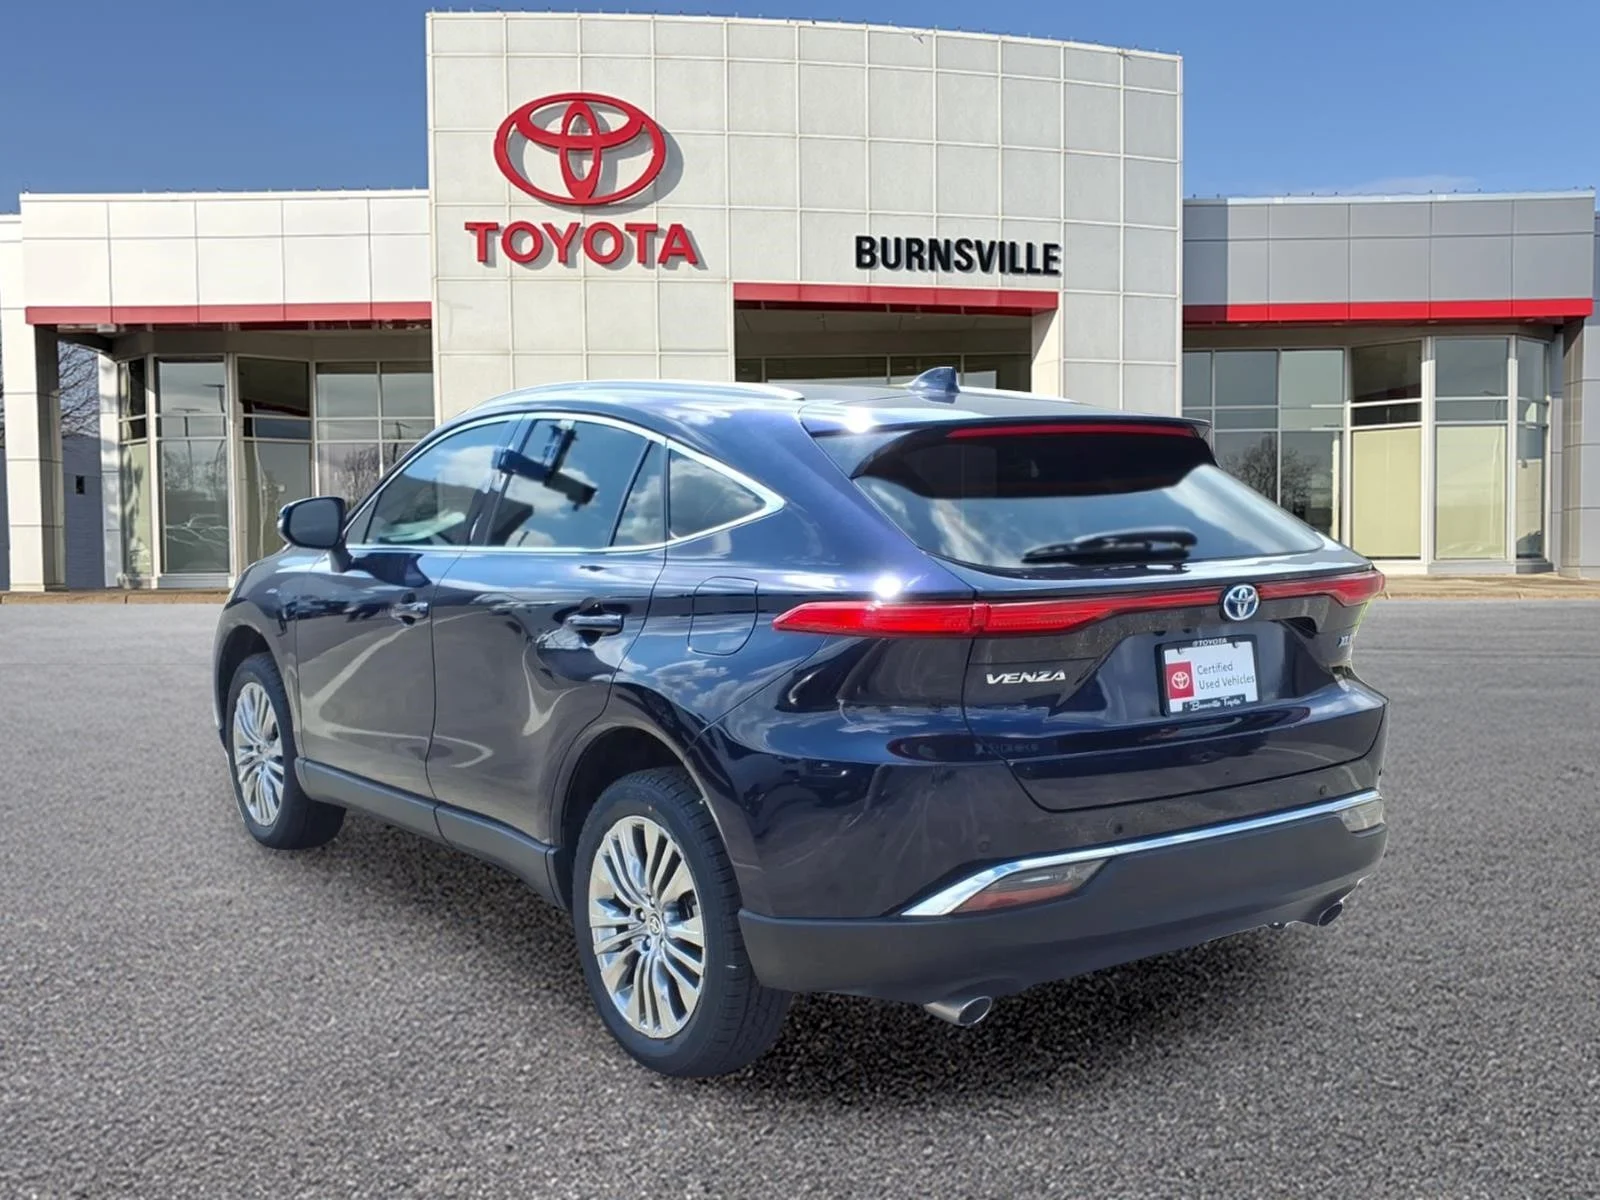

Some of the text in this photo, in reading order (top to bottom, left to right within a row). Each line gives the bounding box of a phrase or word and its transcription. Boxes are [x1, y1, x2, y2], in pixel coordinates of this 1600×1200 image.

[464, 220, 699, 265] TOYOTA
[855, 235, 1061, 276] BURNSVILLE
[1197, 661, 1233, 675] Certified
[986, 669, 1066, 685] VENZA
[1198, 674, 1255, 690] Used Vehicles
